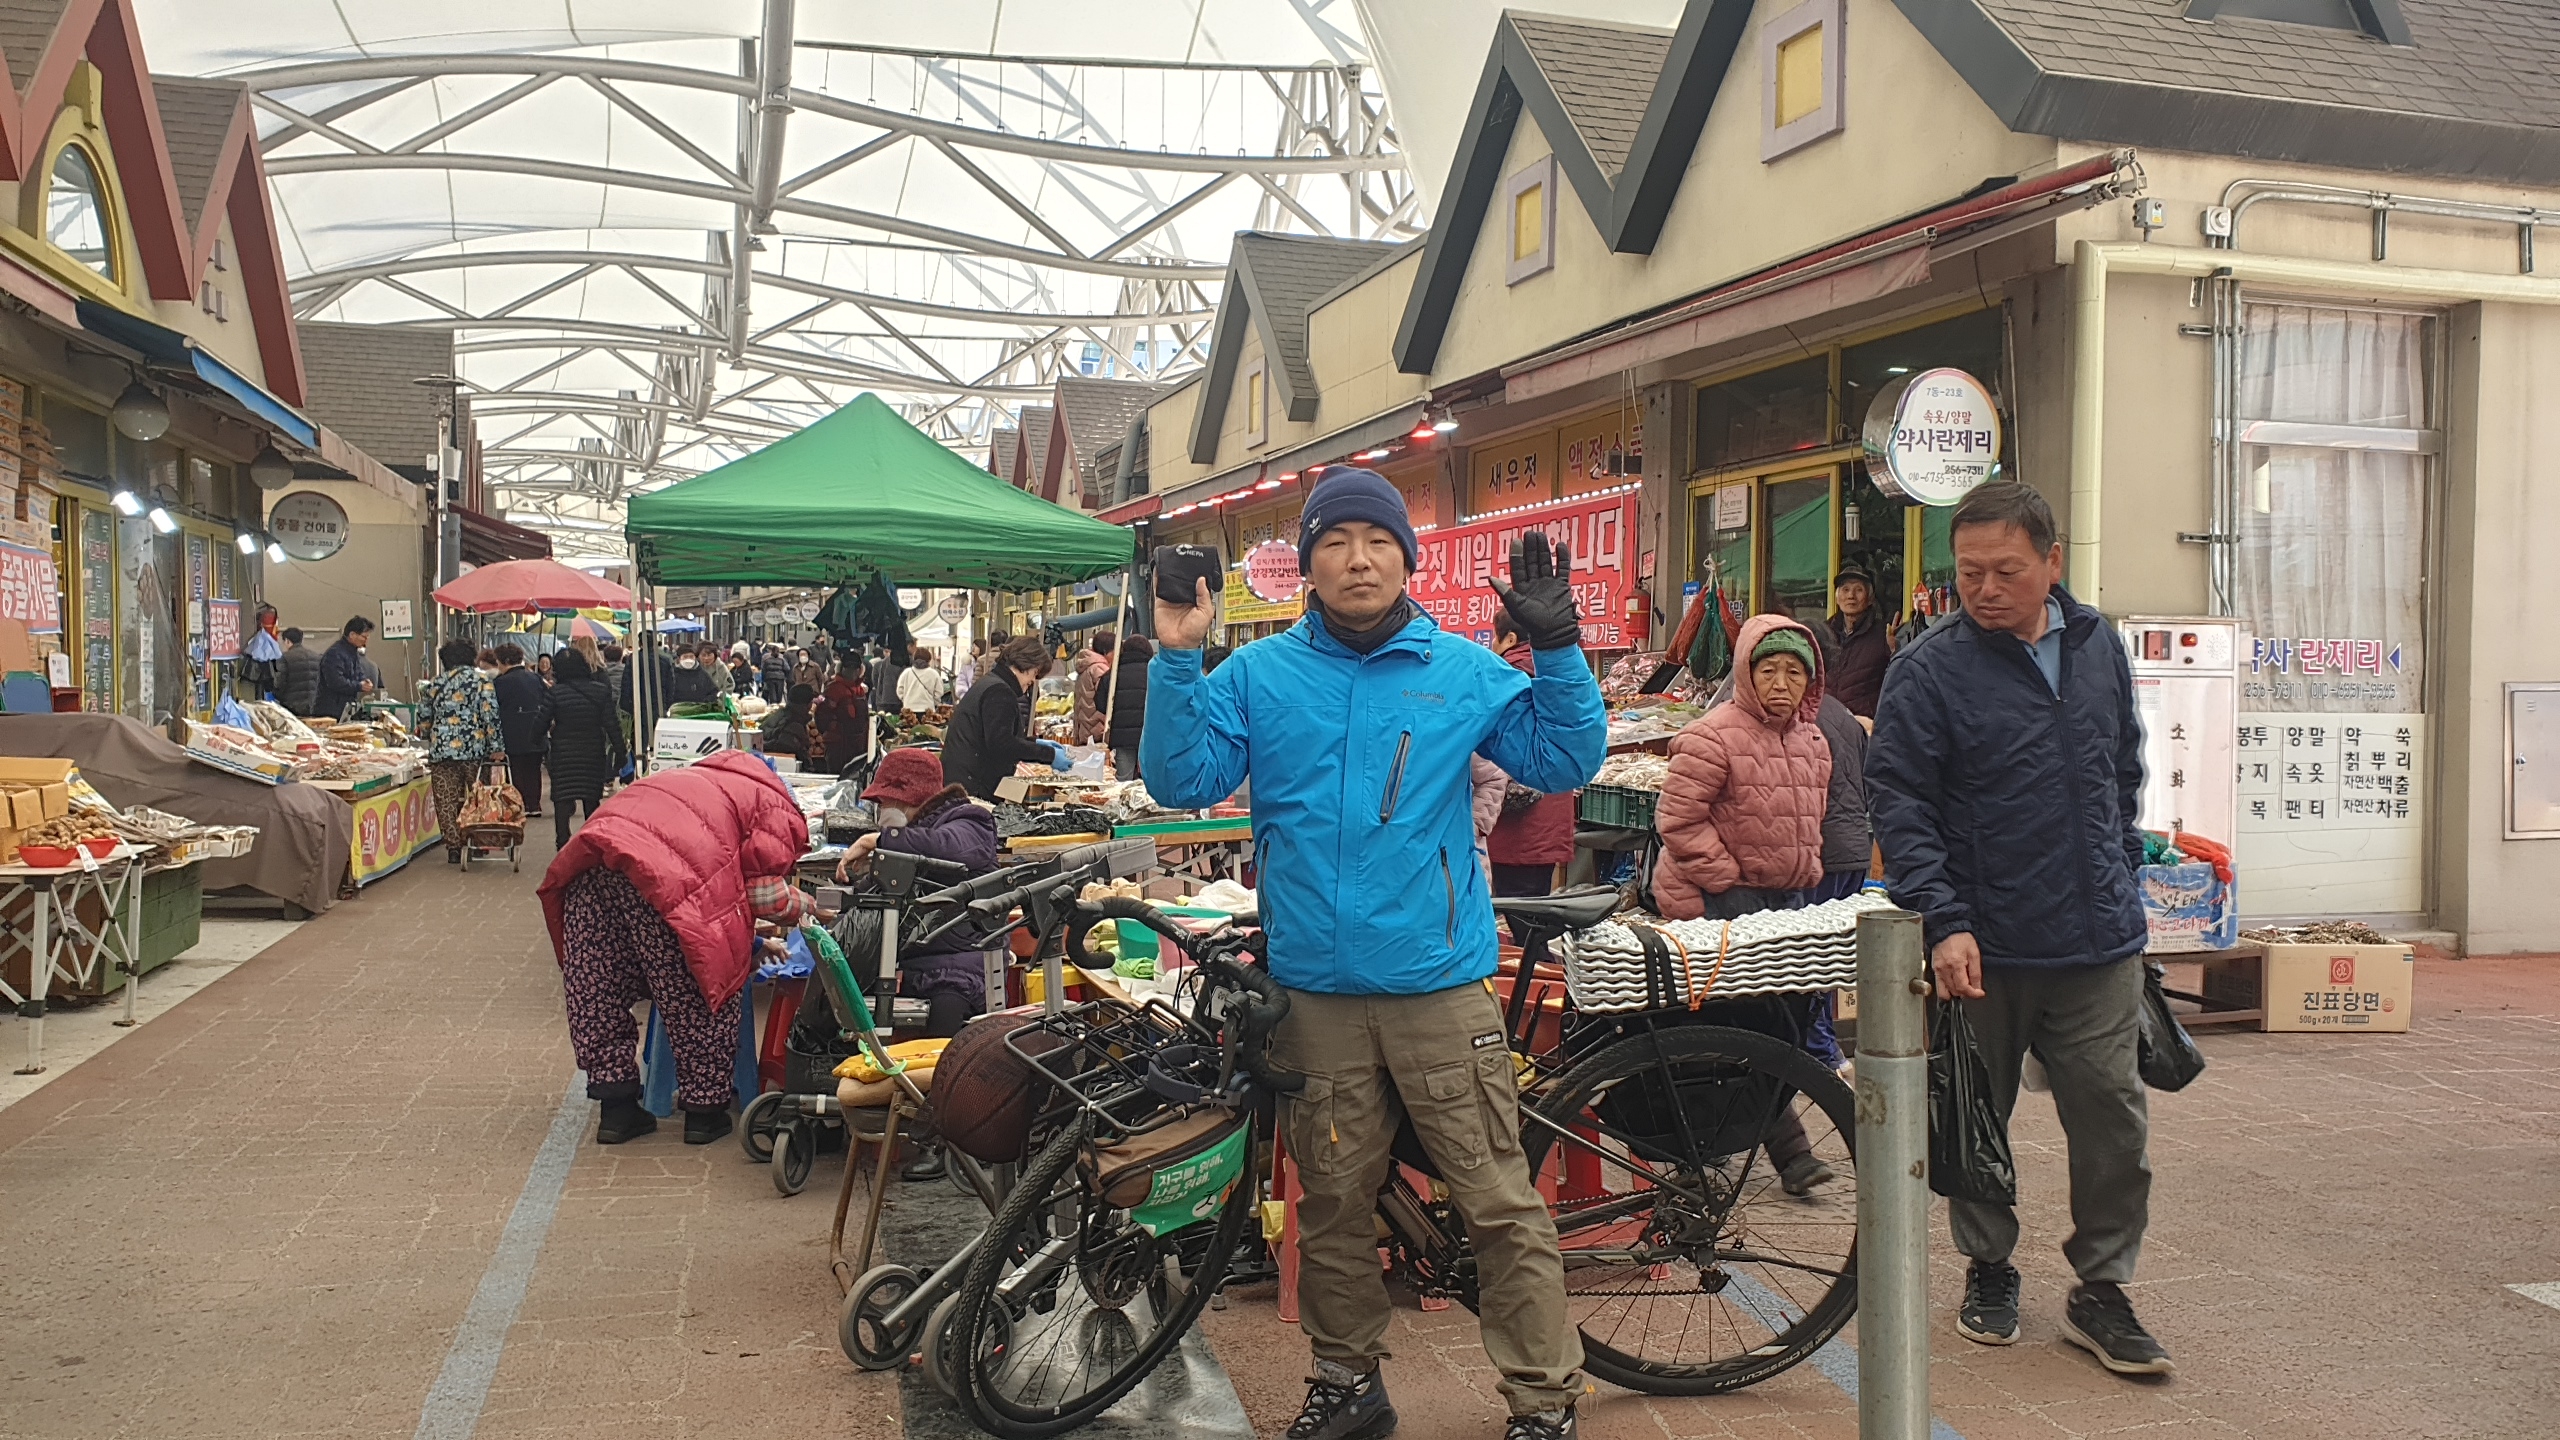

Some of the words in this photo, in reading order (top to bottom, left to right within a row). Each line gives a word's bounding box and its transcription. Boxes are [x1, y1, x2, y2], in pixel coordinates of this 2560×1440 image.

[1926, 387, 1963, 398] 7동-23호
[1923, 409, 1972, 425] 속옷/양말
[1896, 428, 1992, 454] 약사란제리
[1489, 453, 1537, 494] 새우젓
[304, 521, 337, 533] 건어물
[1186, 549, 1204, 558] NEPA
[1452, 532, 1493, 590] 세일
[1579, 622, 1620, 644] 택배가능
[2300, 638, 2384, 677] 란제리
[1410, 690, 1445, 700] Columbia
[2287, 727, 2326, 747] 양말
[2286, 762, 2325, 784] 속옷
[2286, 800, 2325, 820] 팬티
[2303, 991, 2380, 1012] 진표당면
[1159, 1165, 1196, 1187] 지구를
[1741, 1350, 1800, 1380] CROSSCUT
